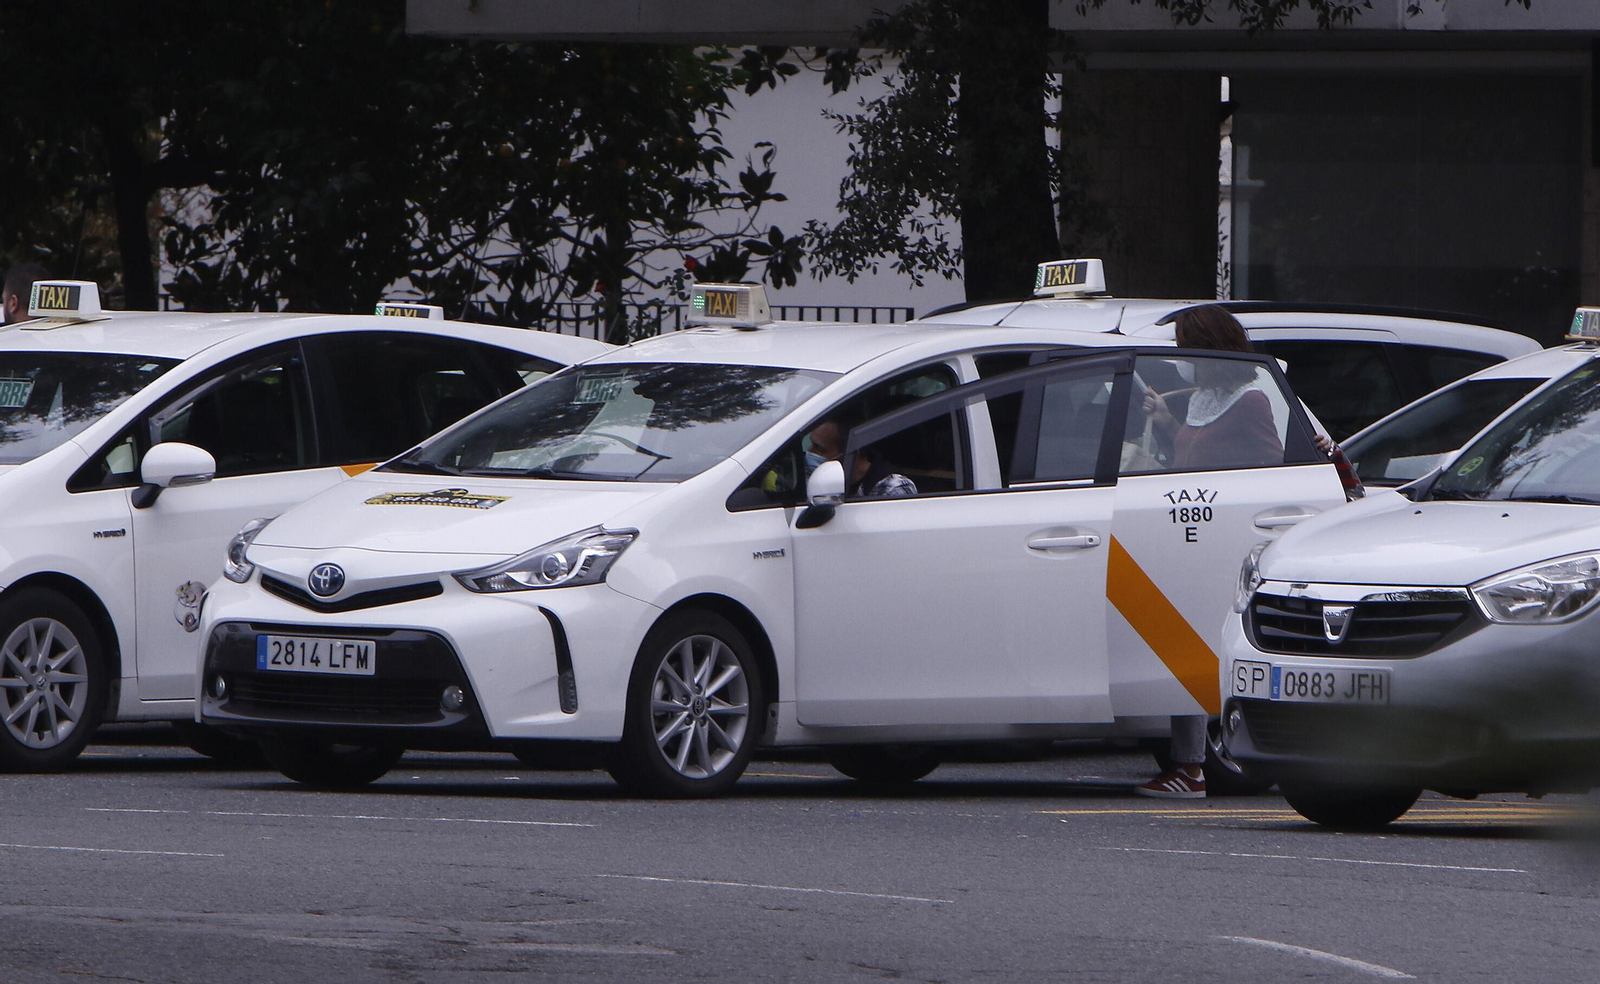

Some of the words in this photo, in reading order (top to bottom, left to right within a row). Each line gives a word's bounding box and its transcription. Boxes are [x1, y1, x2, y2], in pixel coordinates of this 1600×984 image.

[1046, 264, 1076, 285] TAXI
[40, 286, 70, 308] TAXI
[706, 291, 737, 315] TAXI
[0, 382, 31, 405] BRE
[577, 379, 622, 402] LIBRE
[1163, 488, 1218, 504] TAXI
[1168, 506, 1213, 523] 1880
[1185, 526, 1198, 543] E
[271, 640, 321, 667] 2814
[329, 643, 369, 669] LFM
[1236, 666, 1265, 694] SP
[1284, 671, 1335, 697] 0883
[1344, 673, 1383, 700] JFH
